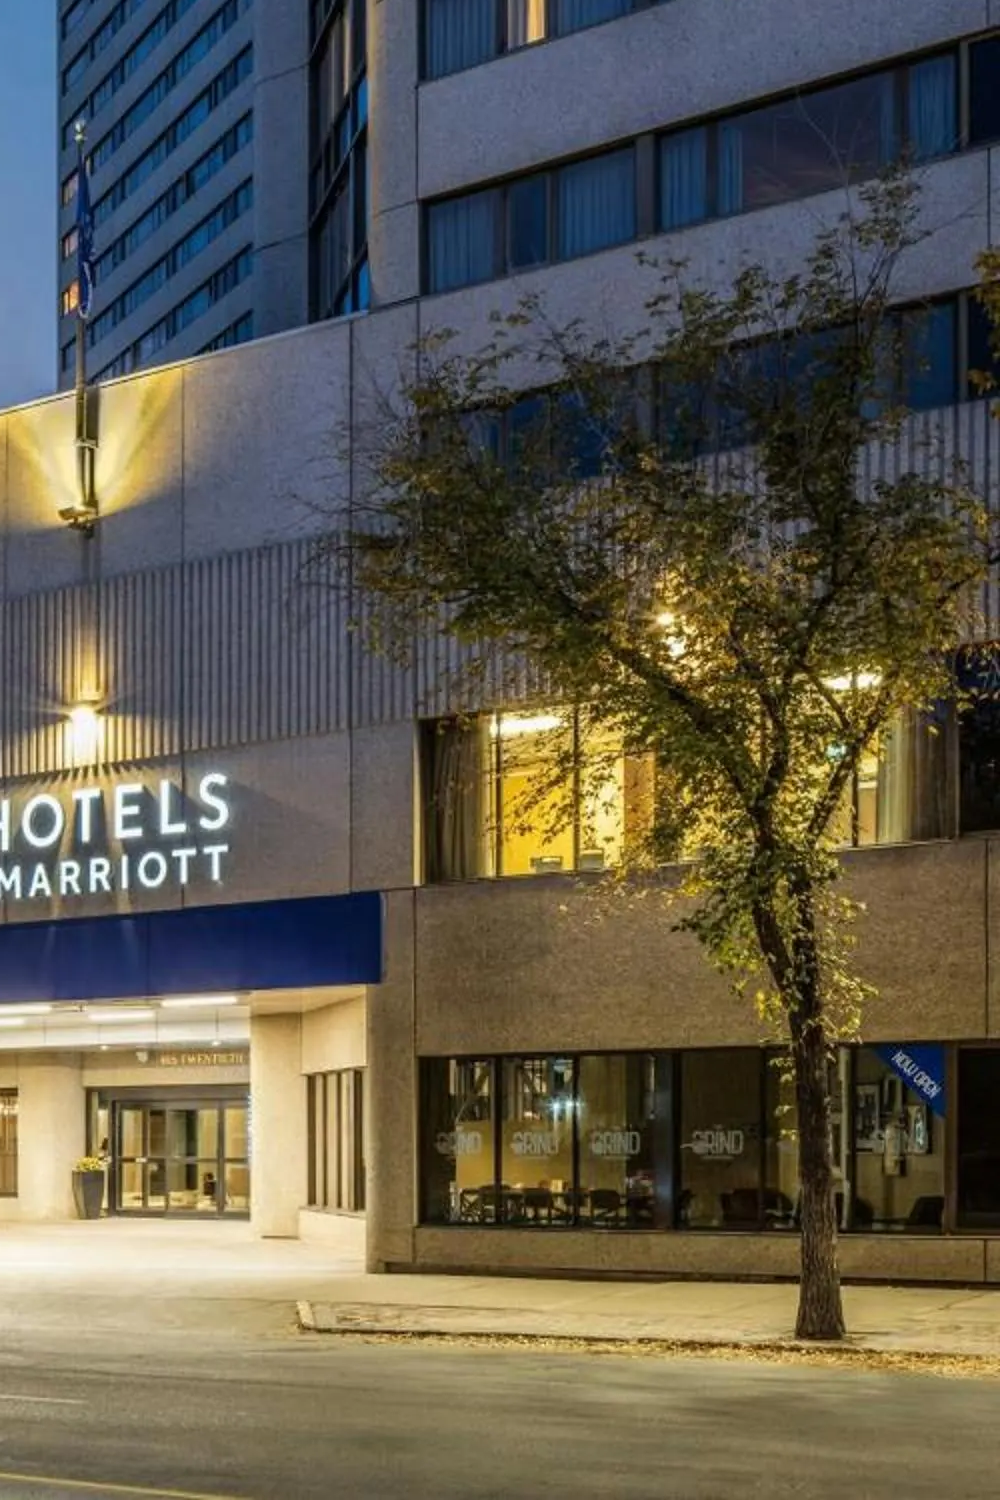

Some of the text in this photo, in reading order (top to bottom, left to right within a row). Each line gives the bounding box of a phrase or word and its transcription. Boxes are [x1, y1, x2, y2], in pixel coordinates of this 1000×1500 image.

[891, 1049, 942, 1099] NOW OPEN
[512, 1131, 560, 1155] GRIND
[592, 1131, 641, 1155] GRIND
[692, 1130, 744, 1155] GRIND
